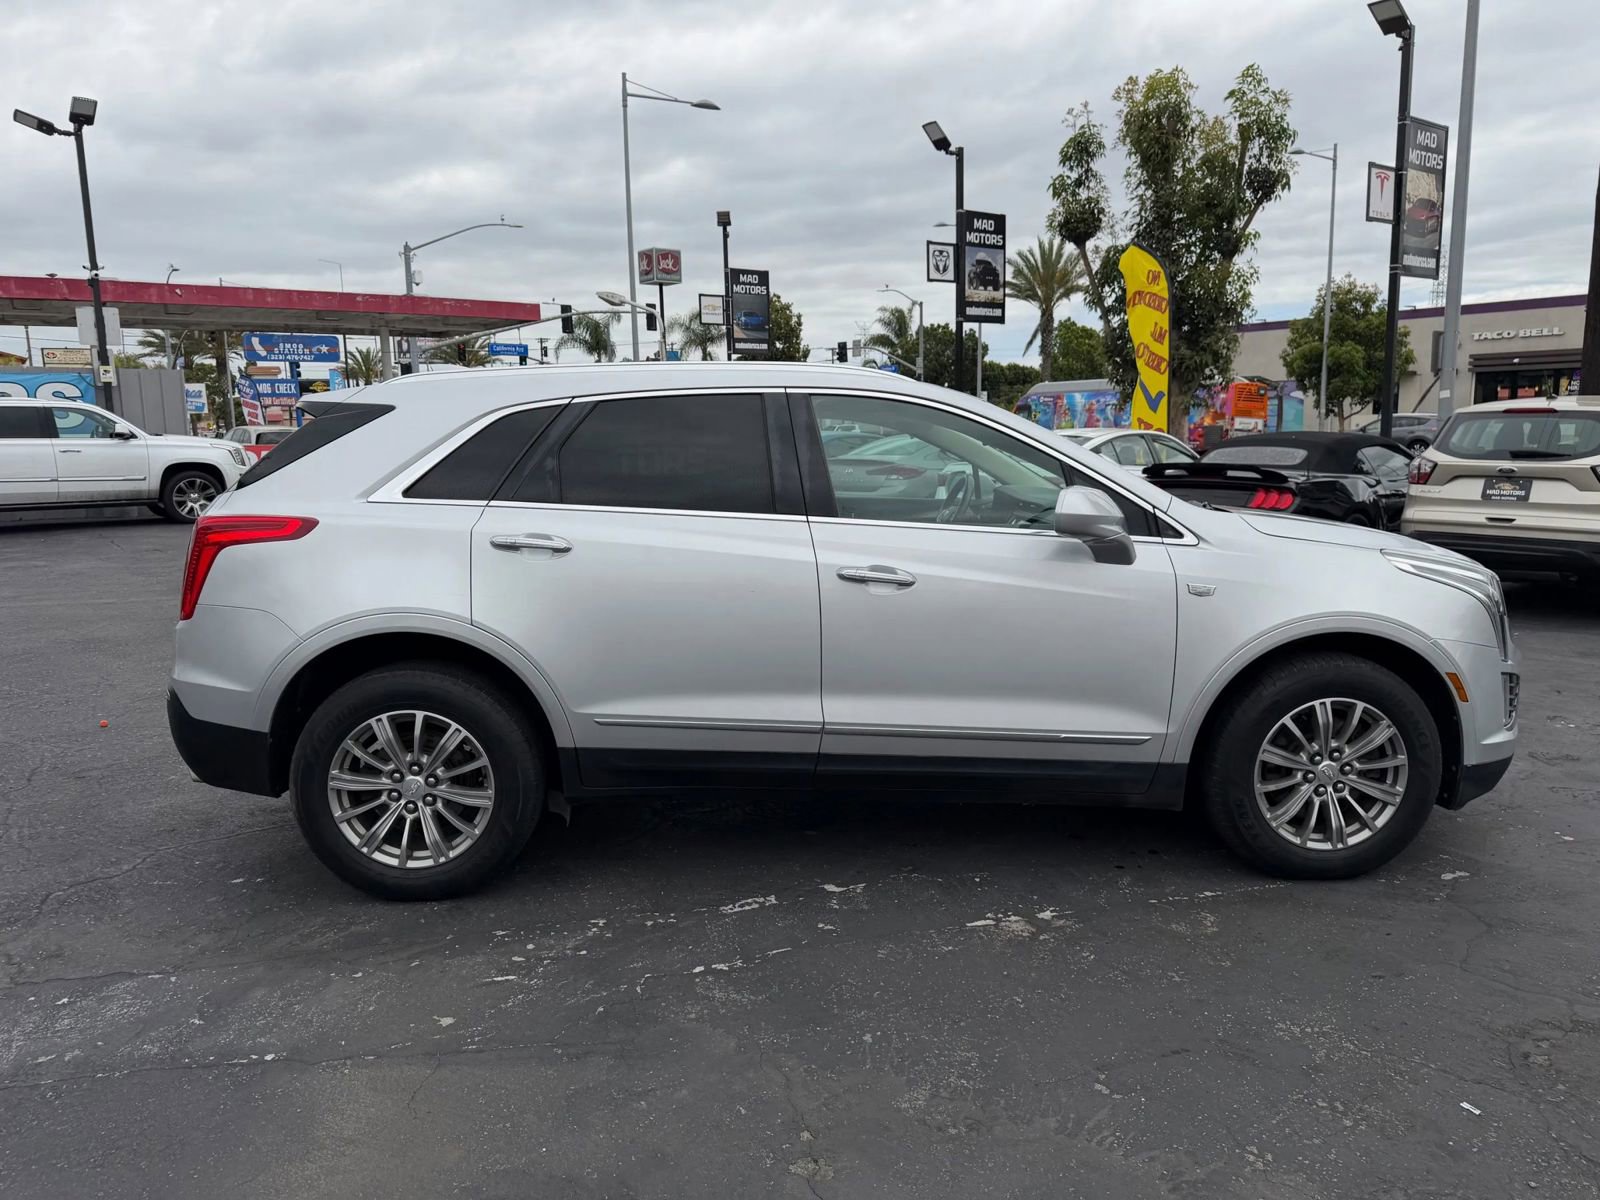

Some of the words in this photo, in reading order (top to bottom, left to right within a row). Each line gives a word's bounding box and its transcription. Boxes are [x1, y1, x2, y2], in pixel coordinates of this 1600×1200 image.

[1416, 129, 1438, 149] MAD
[1409, 147, 1444, 170] MOTORS
[973, 218, 995, 231] MAD
[966, 231, 1004, 246] MOTORS
[658, 254, 680, 271] Jack
[739, 274, 759, 284] MAD
[733, 284, 767, 295] MOTORS
[1472, 329, 1516, 340] TACO
[1518, 326, 1565, 338] BELL
[492, 344, 516, 352] California
[275, 383, 297, 394] CHECK
